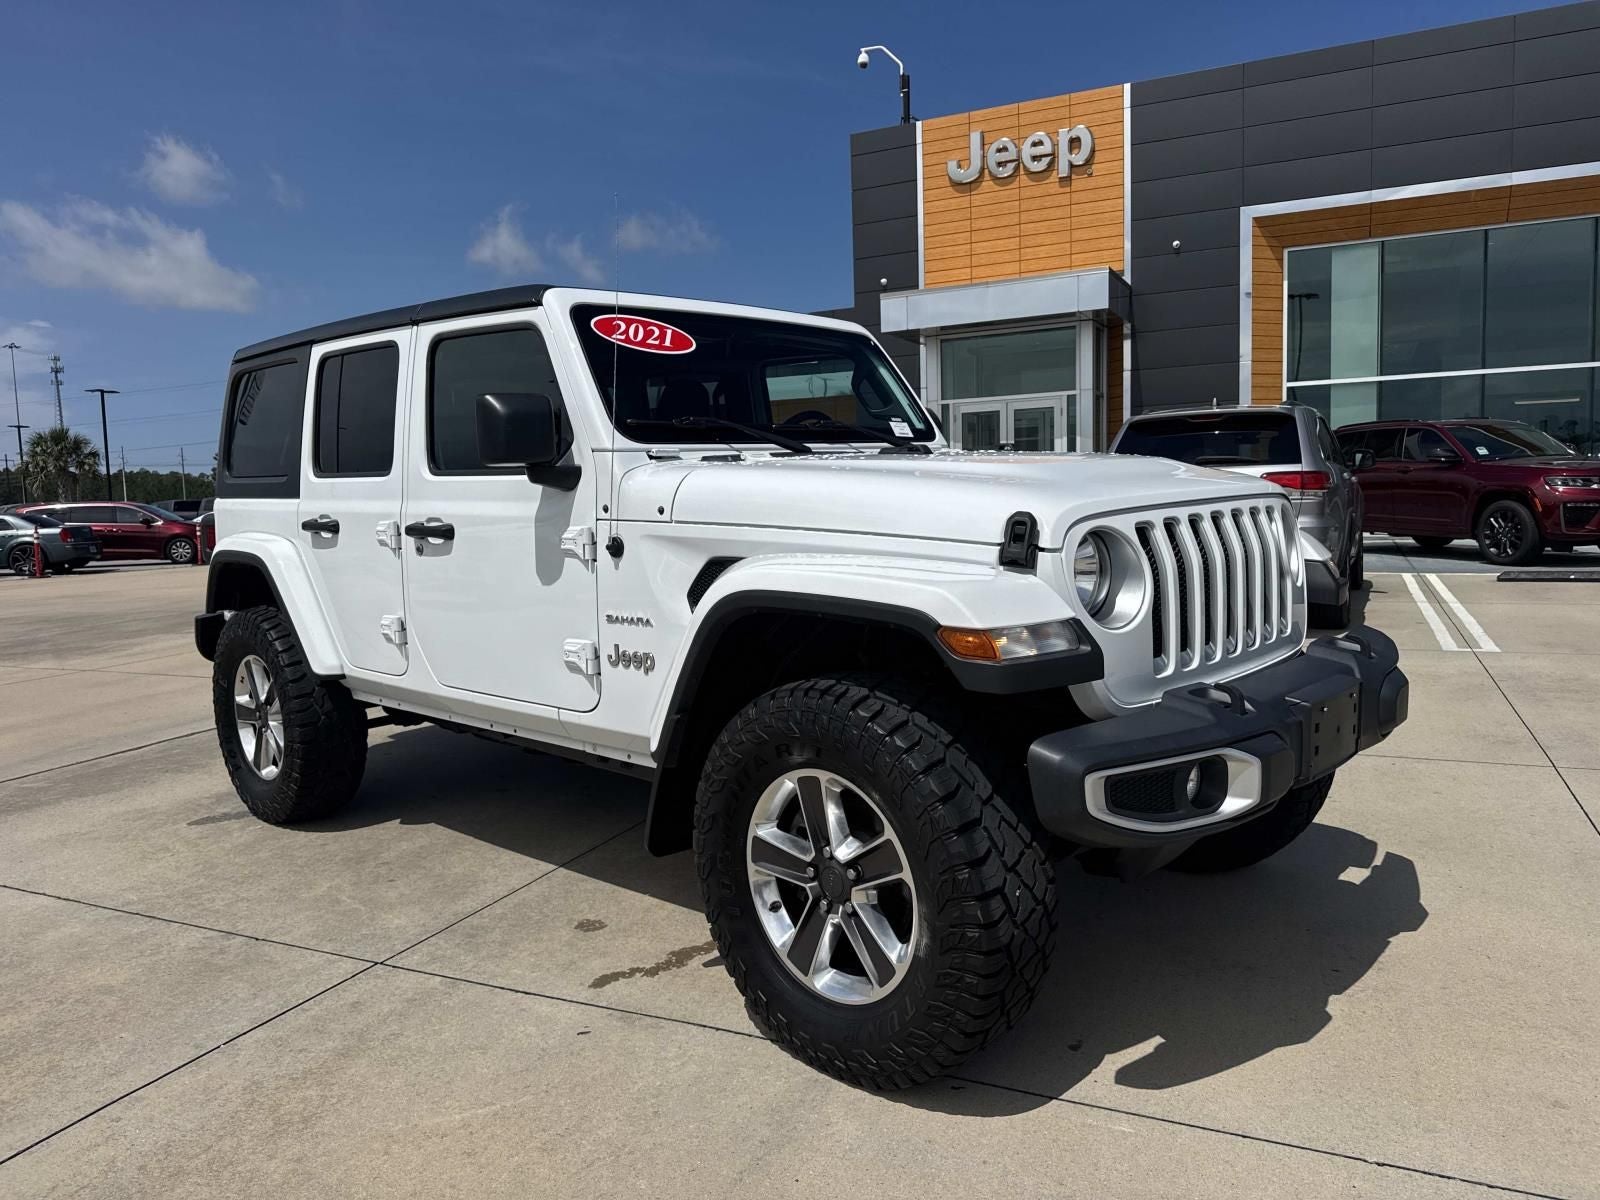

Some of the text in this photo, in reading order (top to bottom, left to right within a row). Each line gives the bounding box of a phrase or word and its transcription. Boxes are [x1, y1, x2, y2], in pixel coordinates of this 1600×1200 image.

[946, 124, 1095, 184] Jeep
[611, 320, 673, 348] 2021
[605, 614, 654, 629] SAHARA
[607, 643, 656, 676] Jeep
